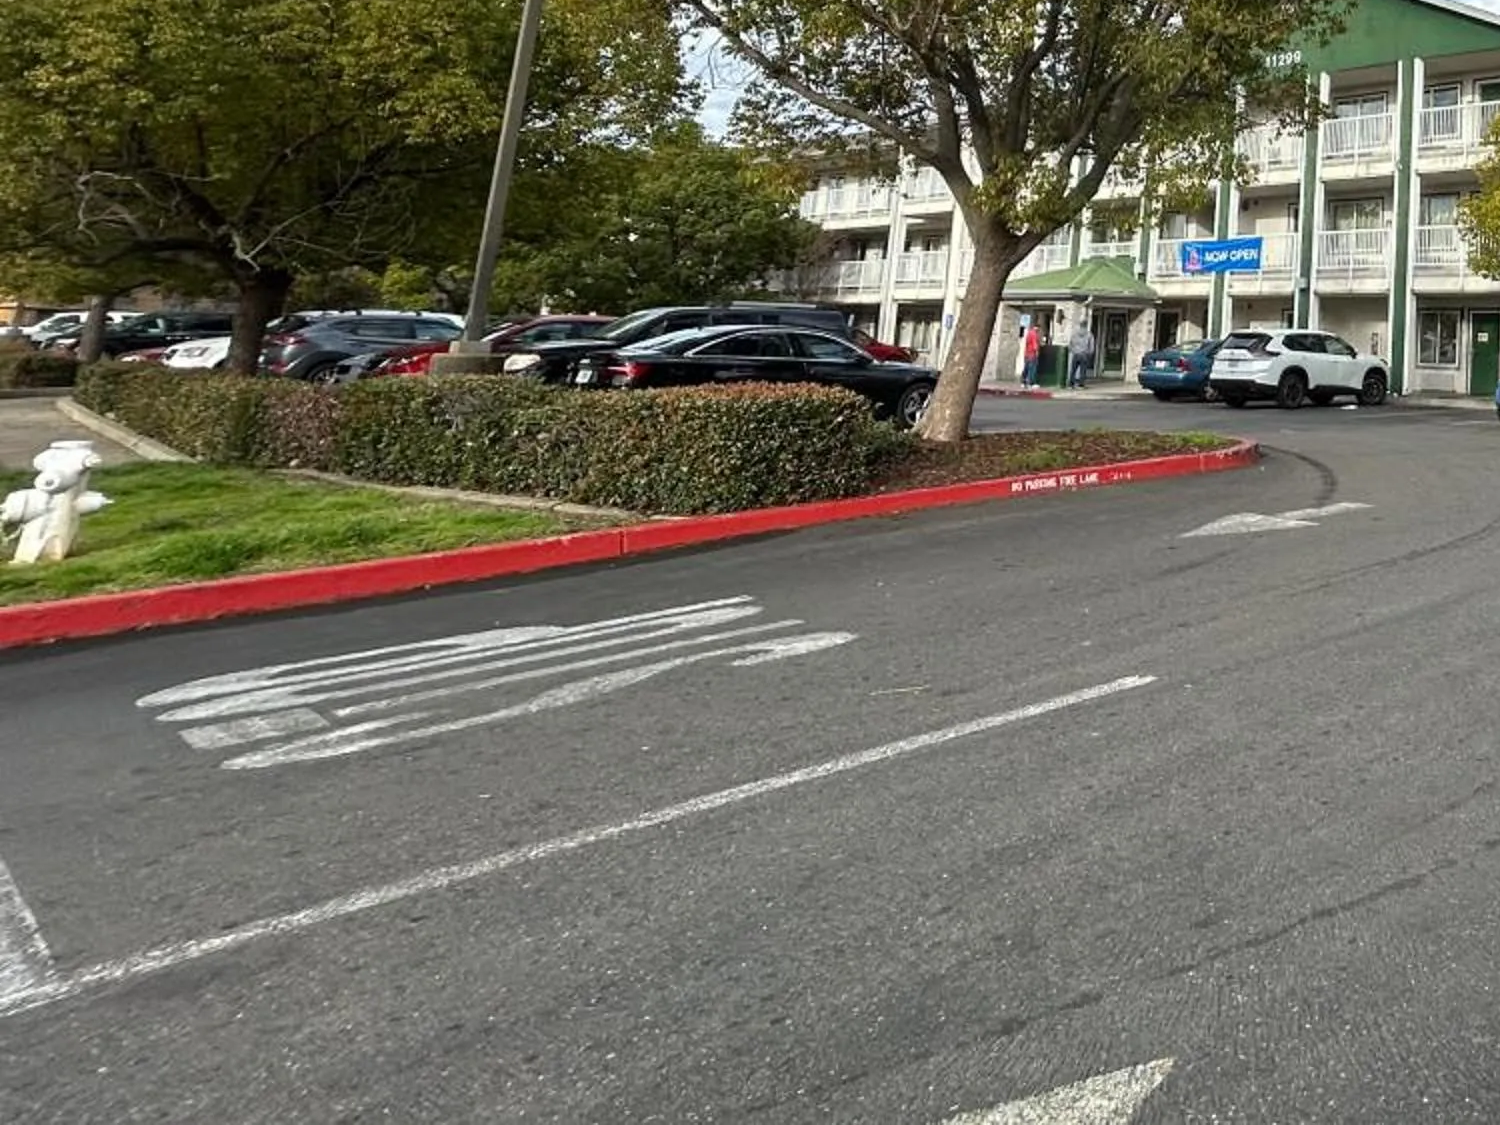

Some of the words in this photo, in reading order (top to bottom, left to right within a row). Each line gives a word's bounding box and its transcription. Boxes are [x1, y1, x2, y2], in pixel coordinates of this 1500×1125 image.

[1205, 251, 1229, 262] NOW
[1230, 249, 1259, 261] OPEN
[1060, 475, 1077, 486] FIRE
[1079, 472, 1099, 484] LANE
[135, 595, 857, 770] STOP
